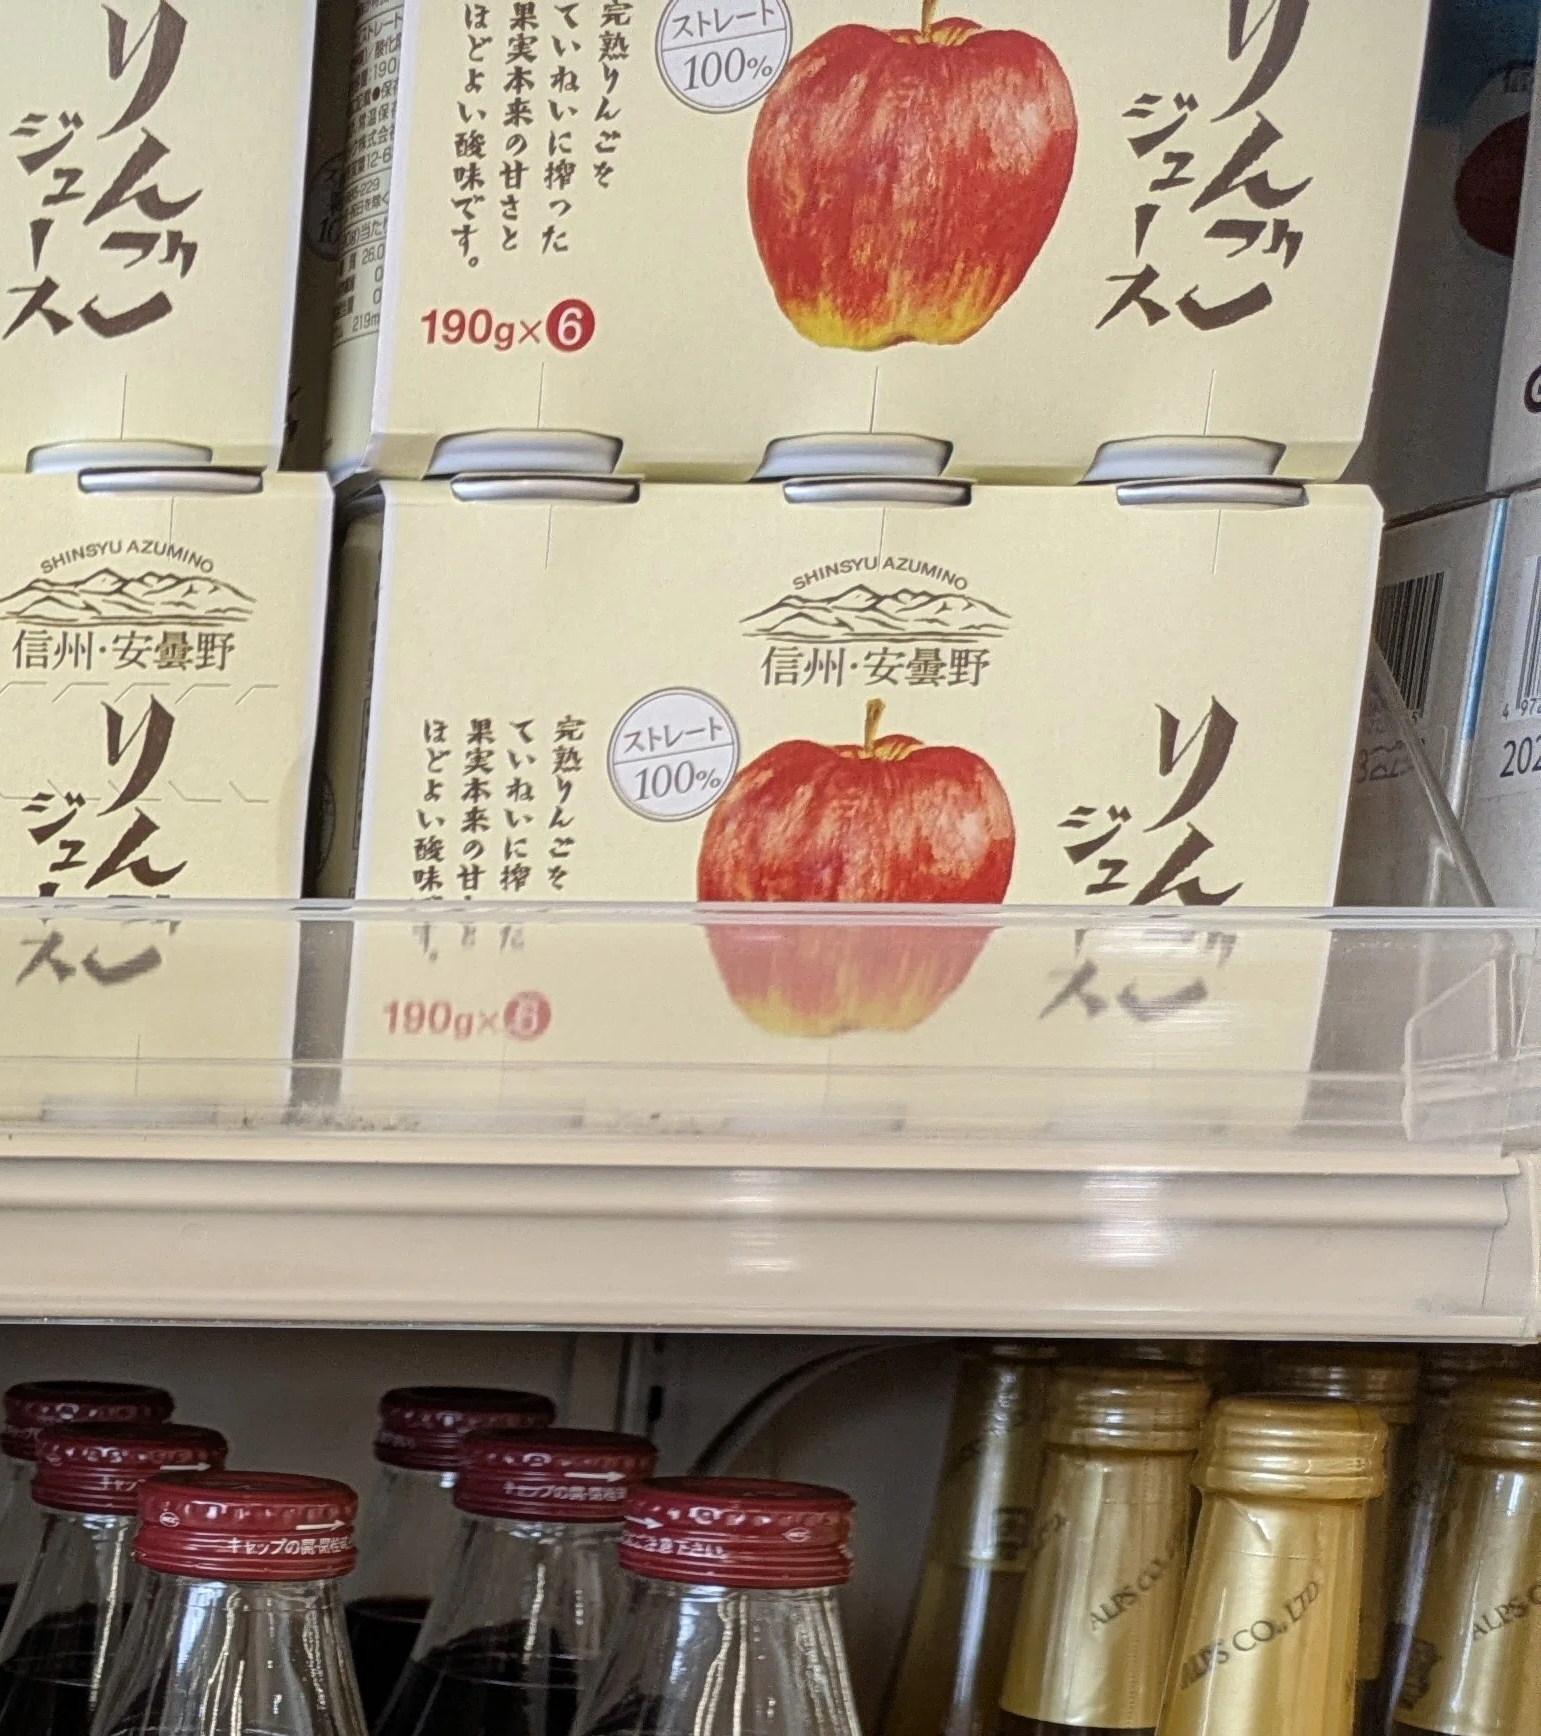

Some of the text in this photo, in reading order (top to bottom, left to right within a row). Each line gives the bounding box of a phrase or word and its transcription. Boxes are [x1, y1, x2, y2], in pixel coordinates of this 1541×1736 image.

[81, 0, 202, 338] りんご
[1095, 91, 1196, 330] ジュース
[40, 539, 215, 575] SHINSYU AZUMINO
[792, 557, 969, 592] SHINSYU AZUMINO
[622, 713, 725, 756] ストレート
[546, 714, 587, 891] 完熟りんごを
[632, 763, 724, 803] 100%
